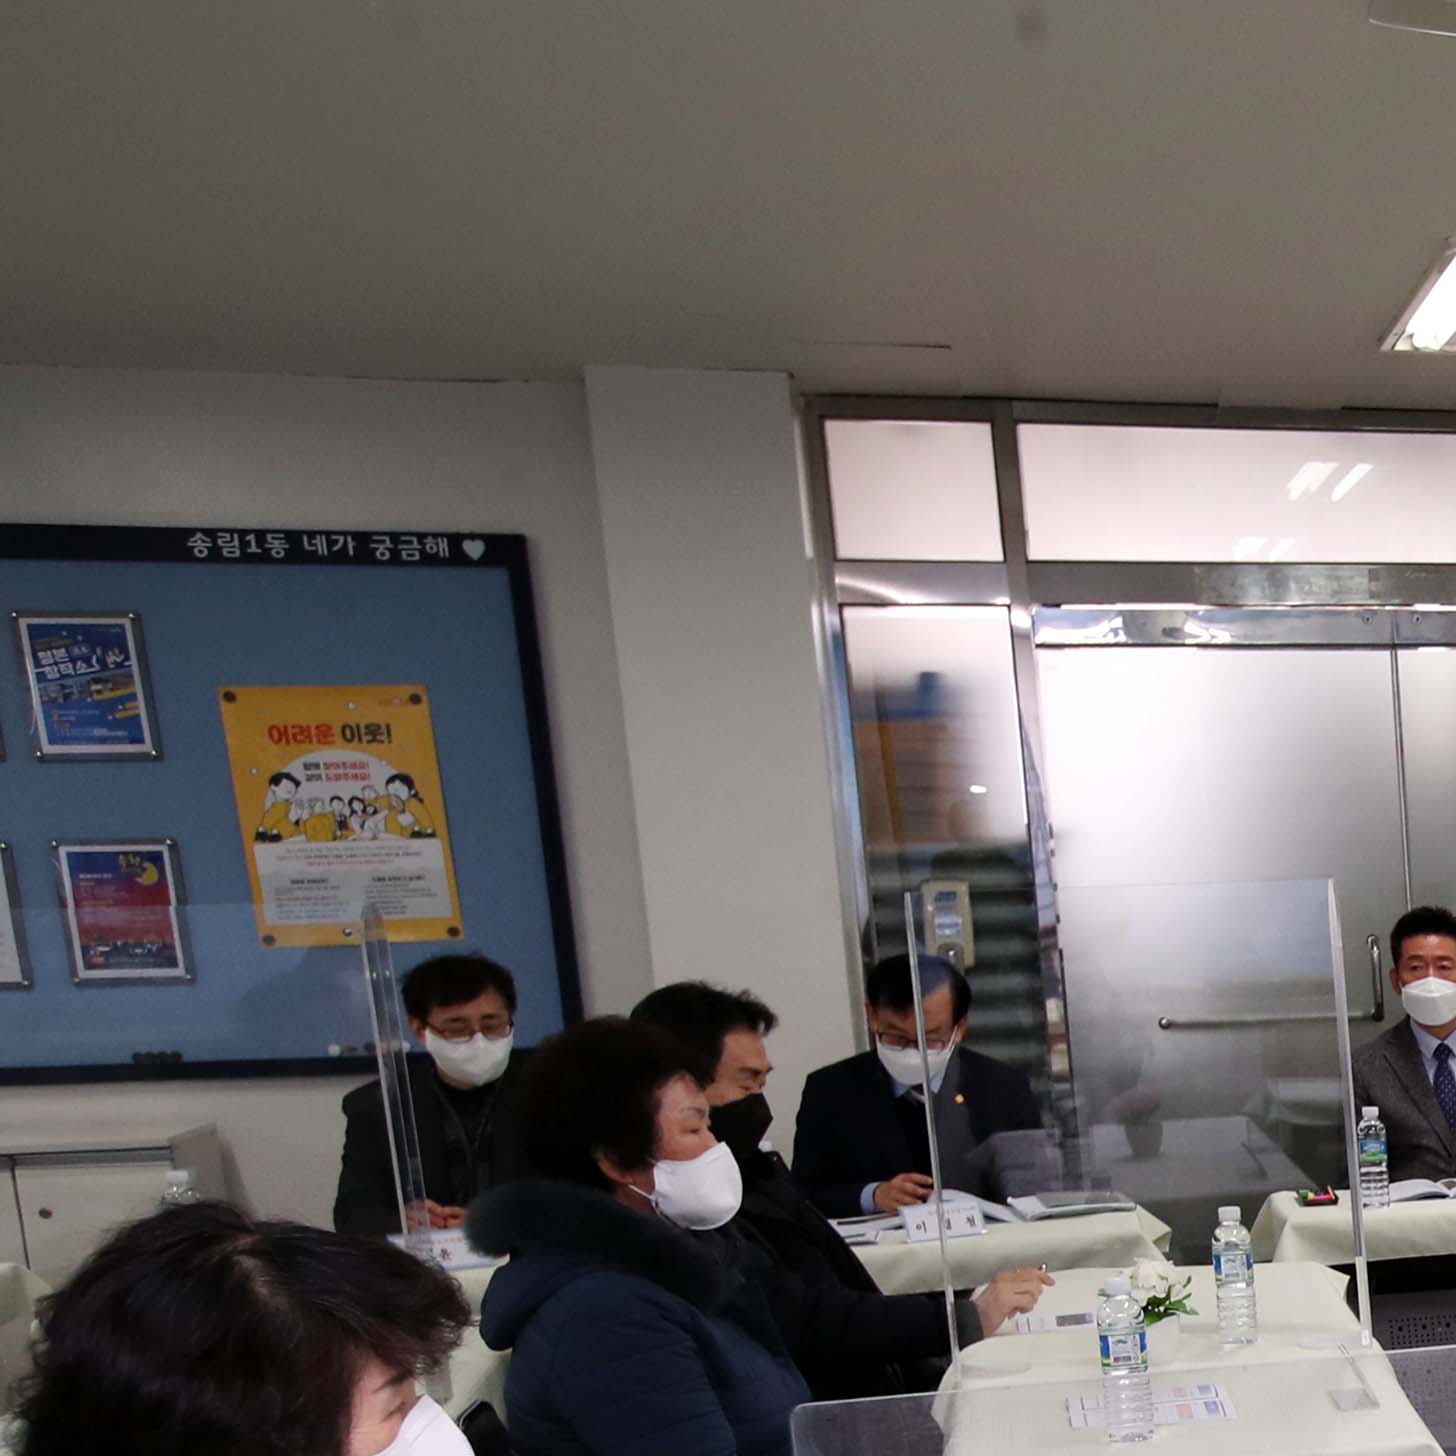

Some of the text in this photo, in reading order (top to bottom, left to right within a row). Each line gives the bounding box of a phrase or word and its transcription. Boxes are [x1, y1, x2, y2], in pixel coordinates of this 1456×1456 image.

[187, 531, 450, 561] 송림1동 네가 궁금해
[267, 722, 392, 746] 어려운 이웃!
